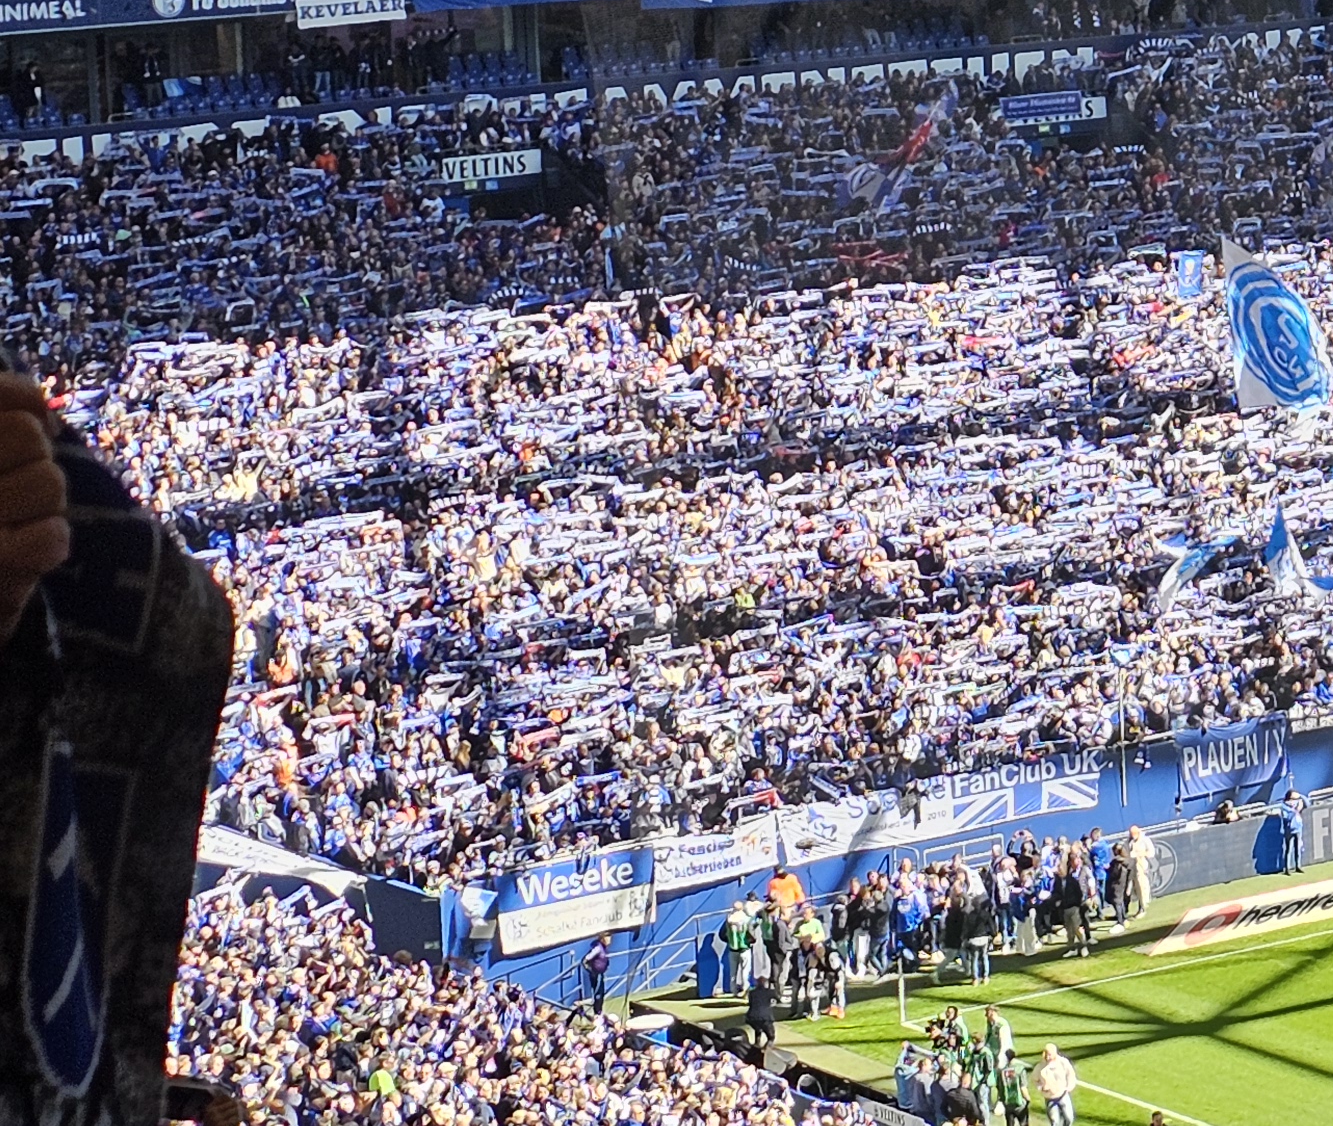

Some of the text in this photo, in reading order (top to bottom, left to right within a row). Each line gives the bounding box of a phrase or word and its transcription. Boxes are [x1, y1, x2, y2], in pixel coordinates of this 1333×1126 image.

[445, 154, 528, 180] VELTINS
[953, 758, 1056, 799] FanClub
[1063, 750, 1100, 775] UK
[1183, 732, 1260, 781] PLAUEN
[516, 859, 635, 906] Weseke
